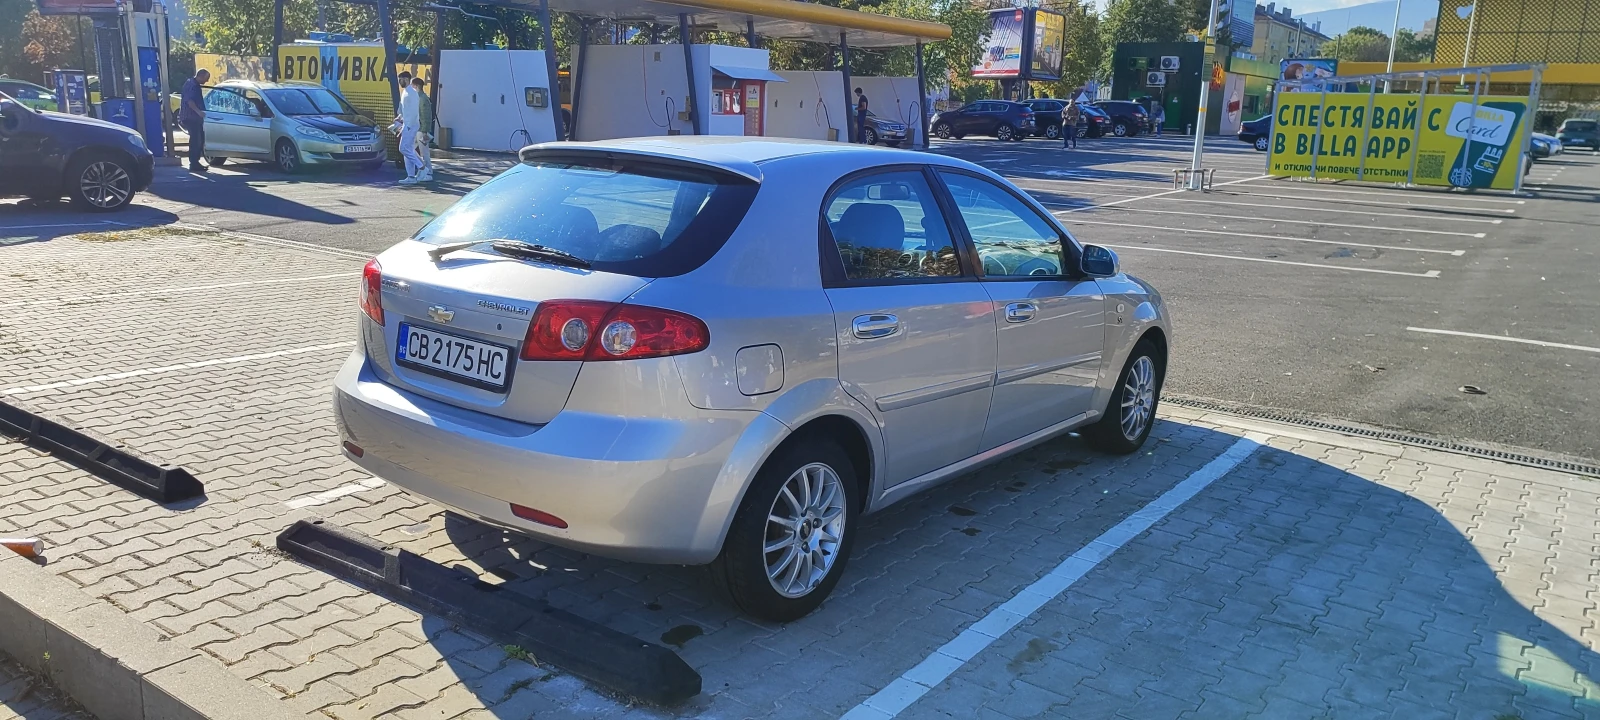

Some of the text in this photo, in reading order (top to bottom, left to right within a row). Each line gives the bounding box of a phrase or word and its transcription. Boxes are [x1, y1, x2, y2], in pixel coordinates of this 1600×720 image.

[1278, 100, 1442, 131] СПЕСТЯВАЙ С
[1296, 133, 1357, 157] BILLA
[1366, 136, 1411, 159] APP
[1327, 166, 1360, 174] ПОВЕЧЕ
[1363, 167, 1409, 177] ОТСТЪПКИ
[477, 299, 530, 315] CHEVROLET
[408, 331, 430, 360] CB
[431, 337, 475, 372] 2175
[476, 347, 503, 380] HC
